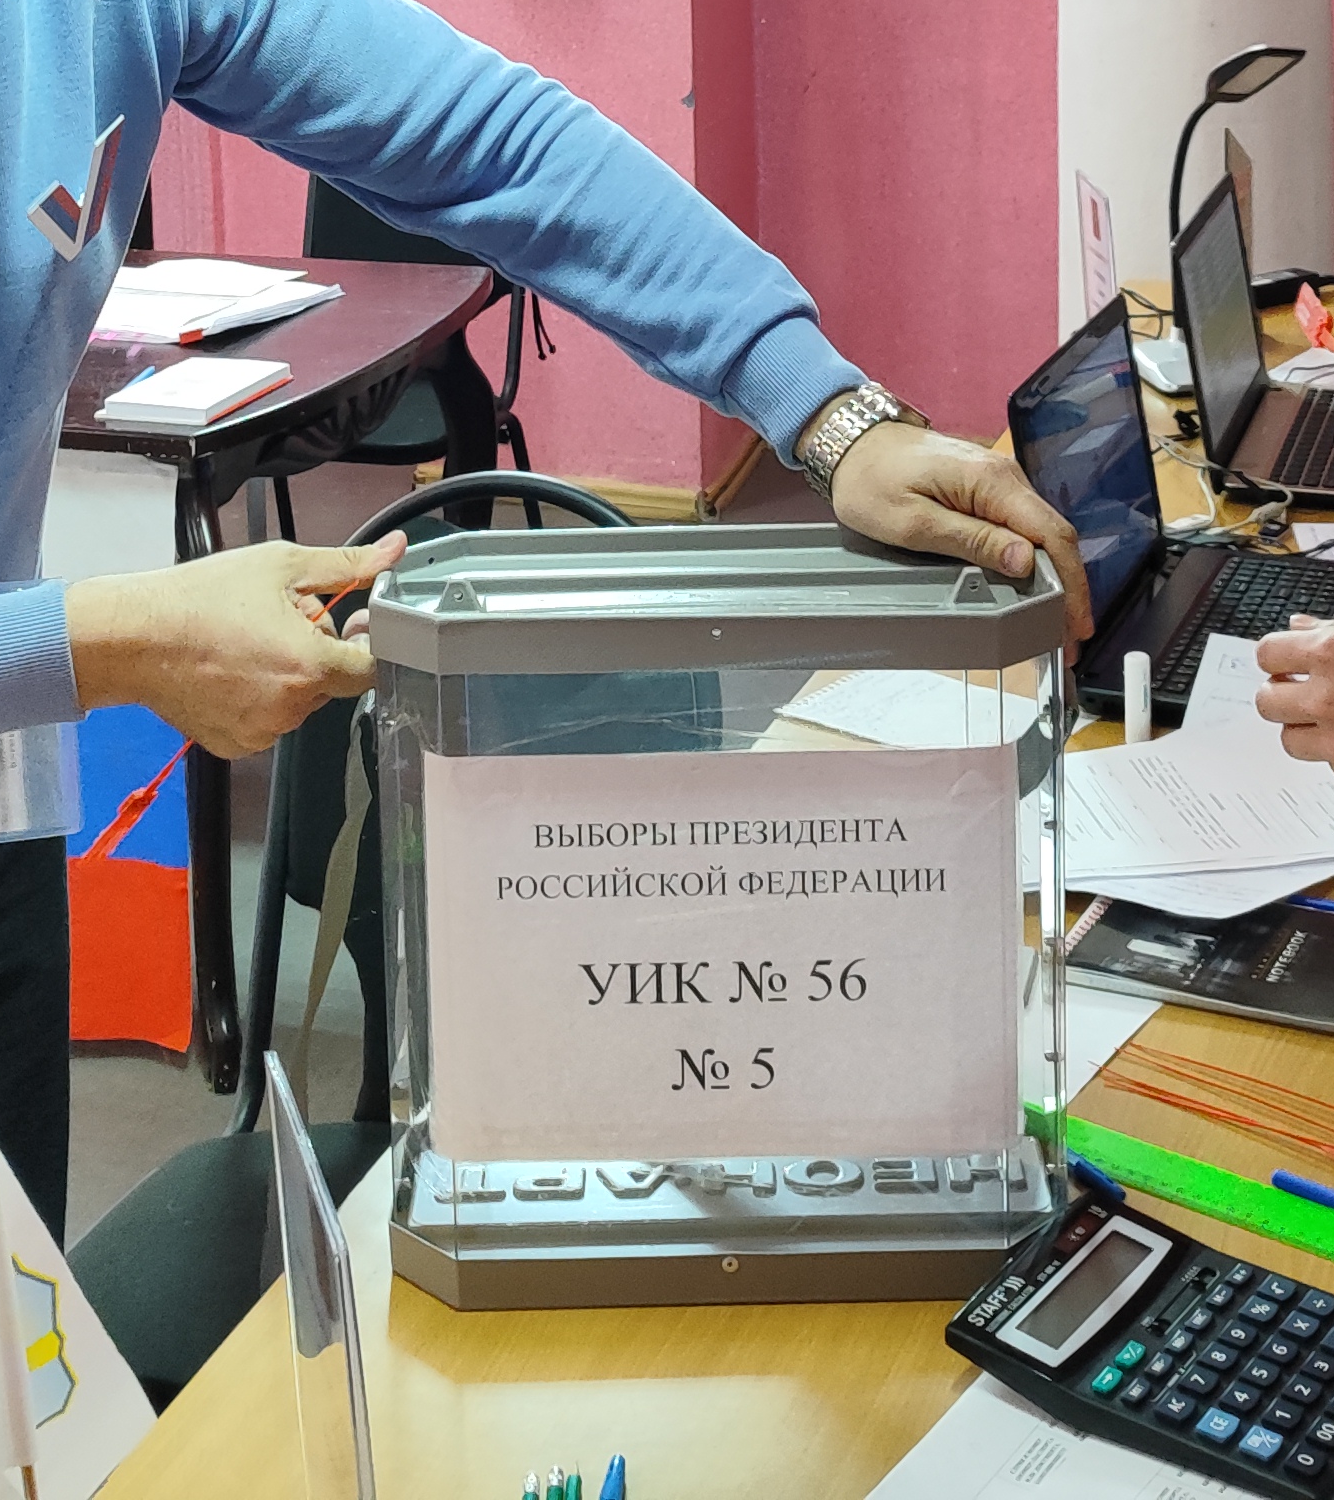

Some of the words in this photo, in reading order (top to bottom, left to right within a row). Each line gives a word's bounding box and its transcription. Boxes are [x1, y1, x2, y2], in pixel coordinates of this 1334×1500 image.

[534, 823, 677, 849] ВЫБОРЫ
[689, 817, 908, 850] ПРЕЗИДЕНТА
[496, 866, 729, 901] РОССИЙСКОЙ
[738, 866, 947, 900] ФЕДЕРАЦИИ
[1266, 929, 1309, 983] NOTEBOOK
[578, 962, 713, 1006] УИК
[728, 961, 788, 1003] №
[807, 957, 867, 1002] 56
[671, 1049, 731, 1090] №
[750, 1047, 775, 1090] 5
[968, 1287, 1009, 1327] STAFF
[1230, 1328, 1246, 1340] 9
[1210, 1351, 1227, 1362] 8
[1272, 1343, 1288, 1356] 6
[1251, 1366, 1268, 1380] 5
[1314, 1360, 1330, 1372] 3
[1190, 1374, 1206, 1385] 7
[1234, 1390, 1250, 1404] 4
[1294, 1384, 1312, 1397] 2
[1296, 1453, 1315, 1466] 0
